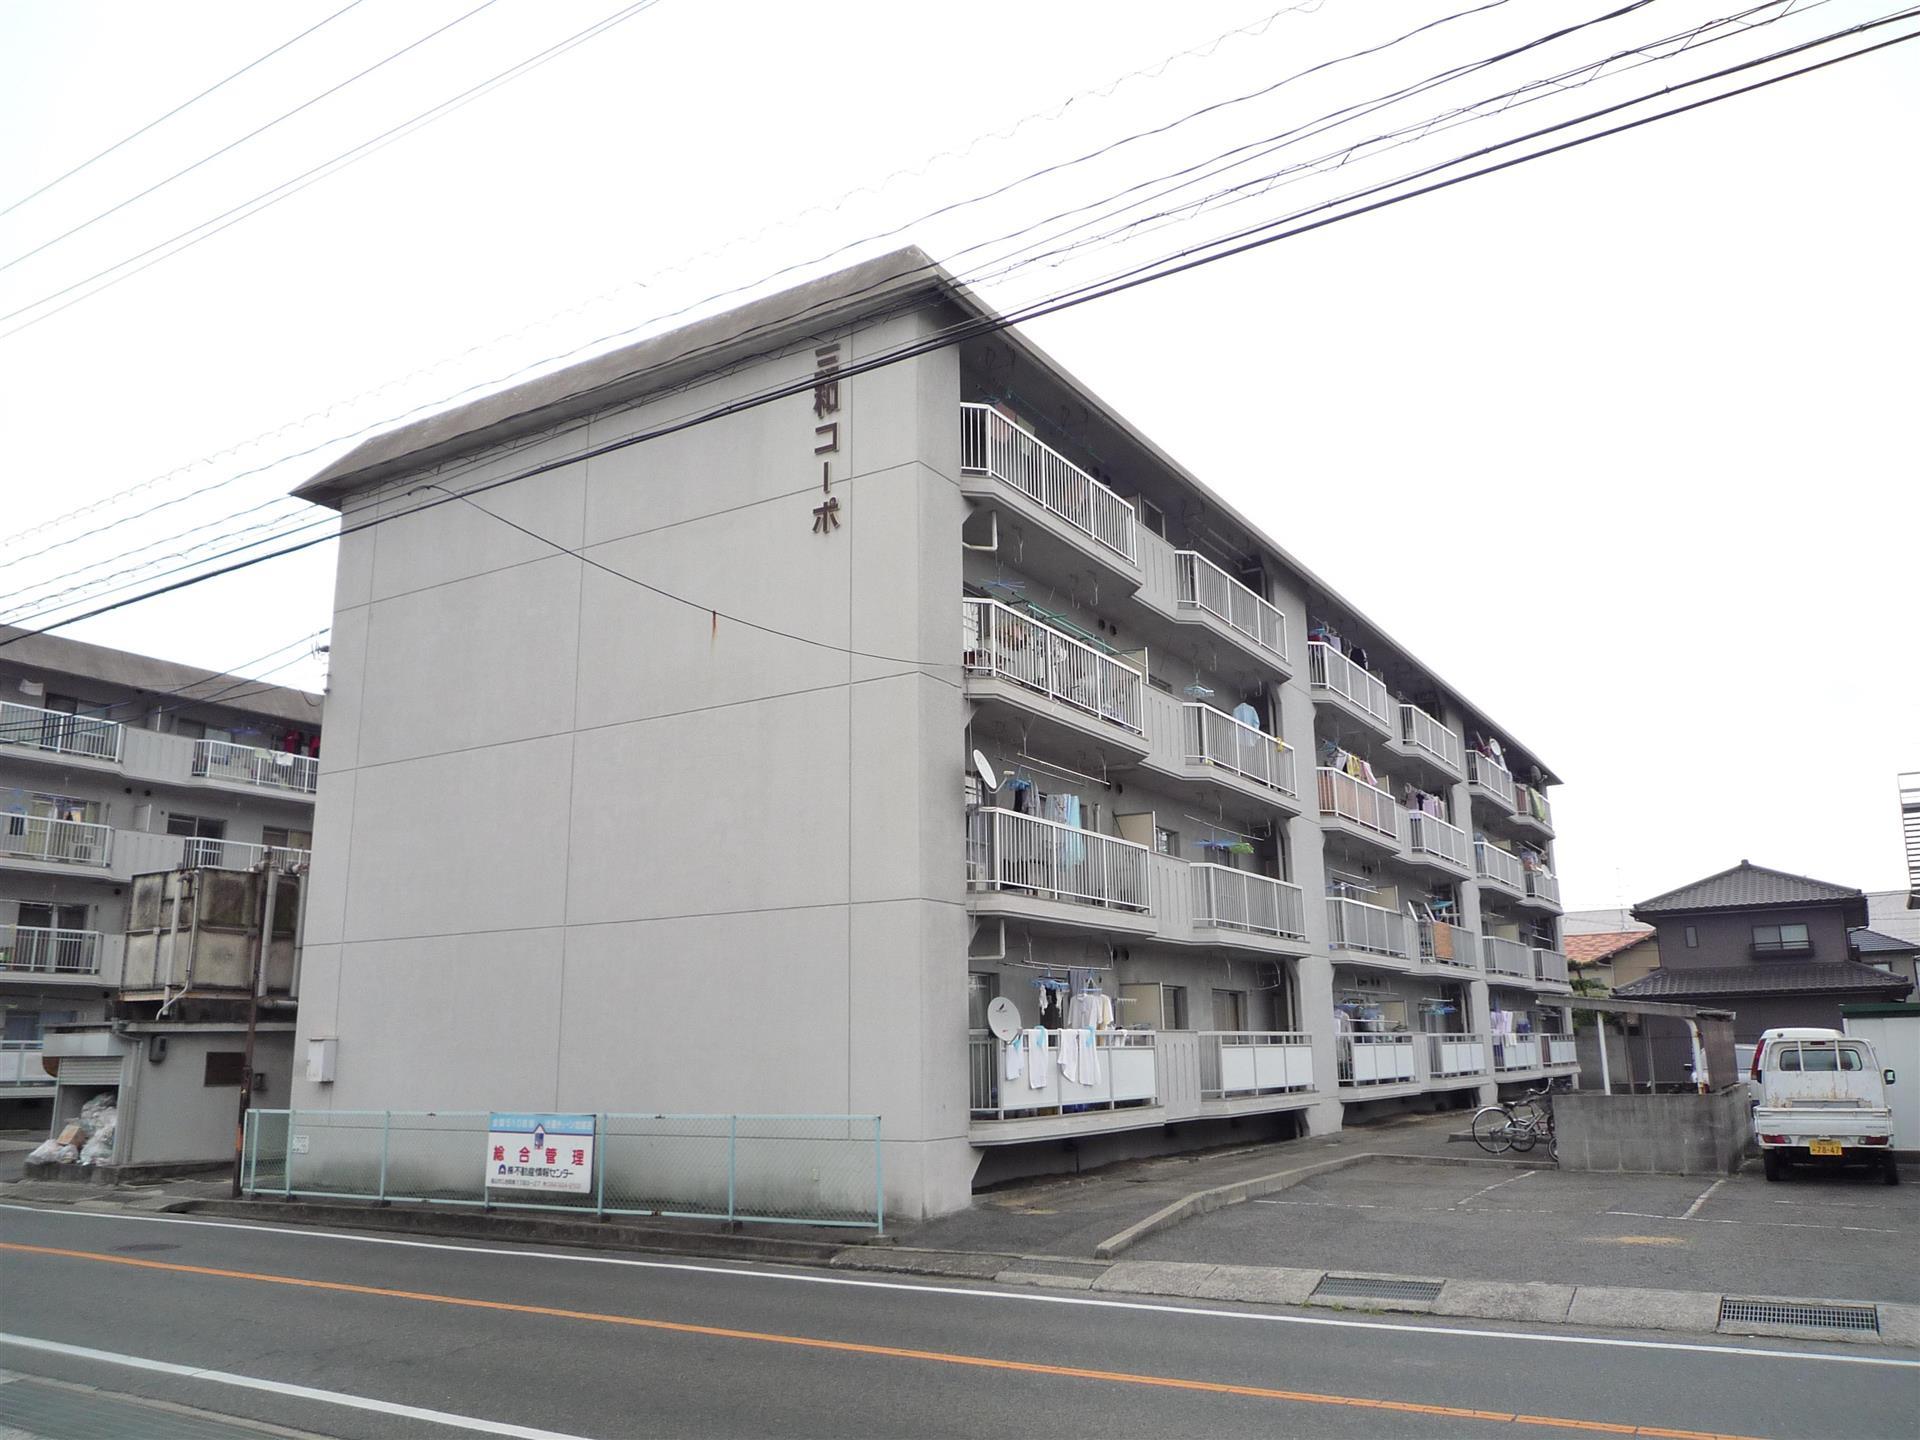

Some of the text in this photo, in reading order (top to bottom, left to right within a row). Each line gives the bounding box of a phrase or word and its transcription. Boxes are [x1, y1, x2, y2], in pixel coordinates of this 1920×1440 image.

[813, 343, 840, 534] 三和コーポ
